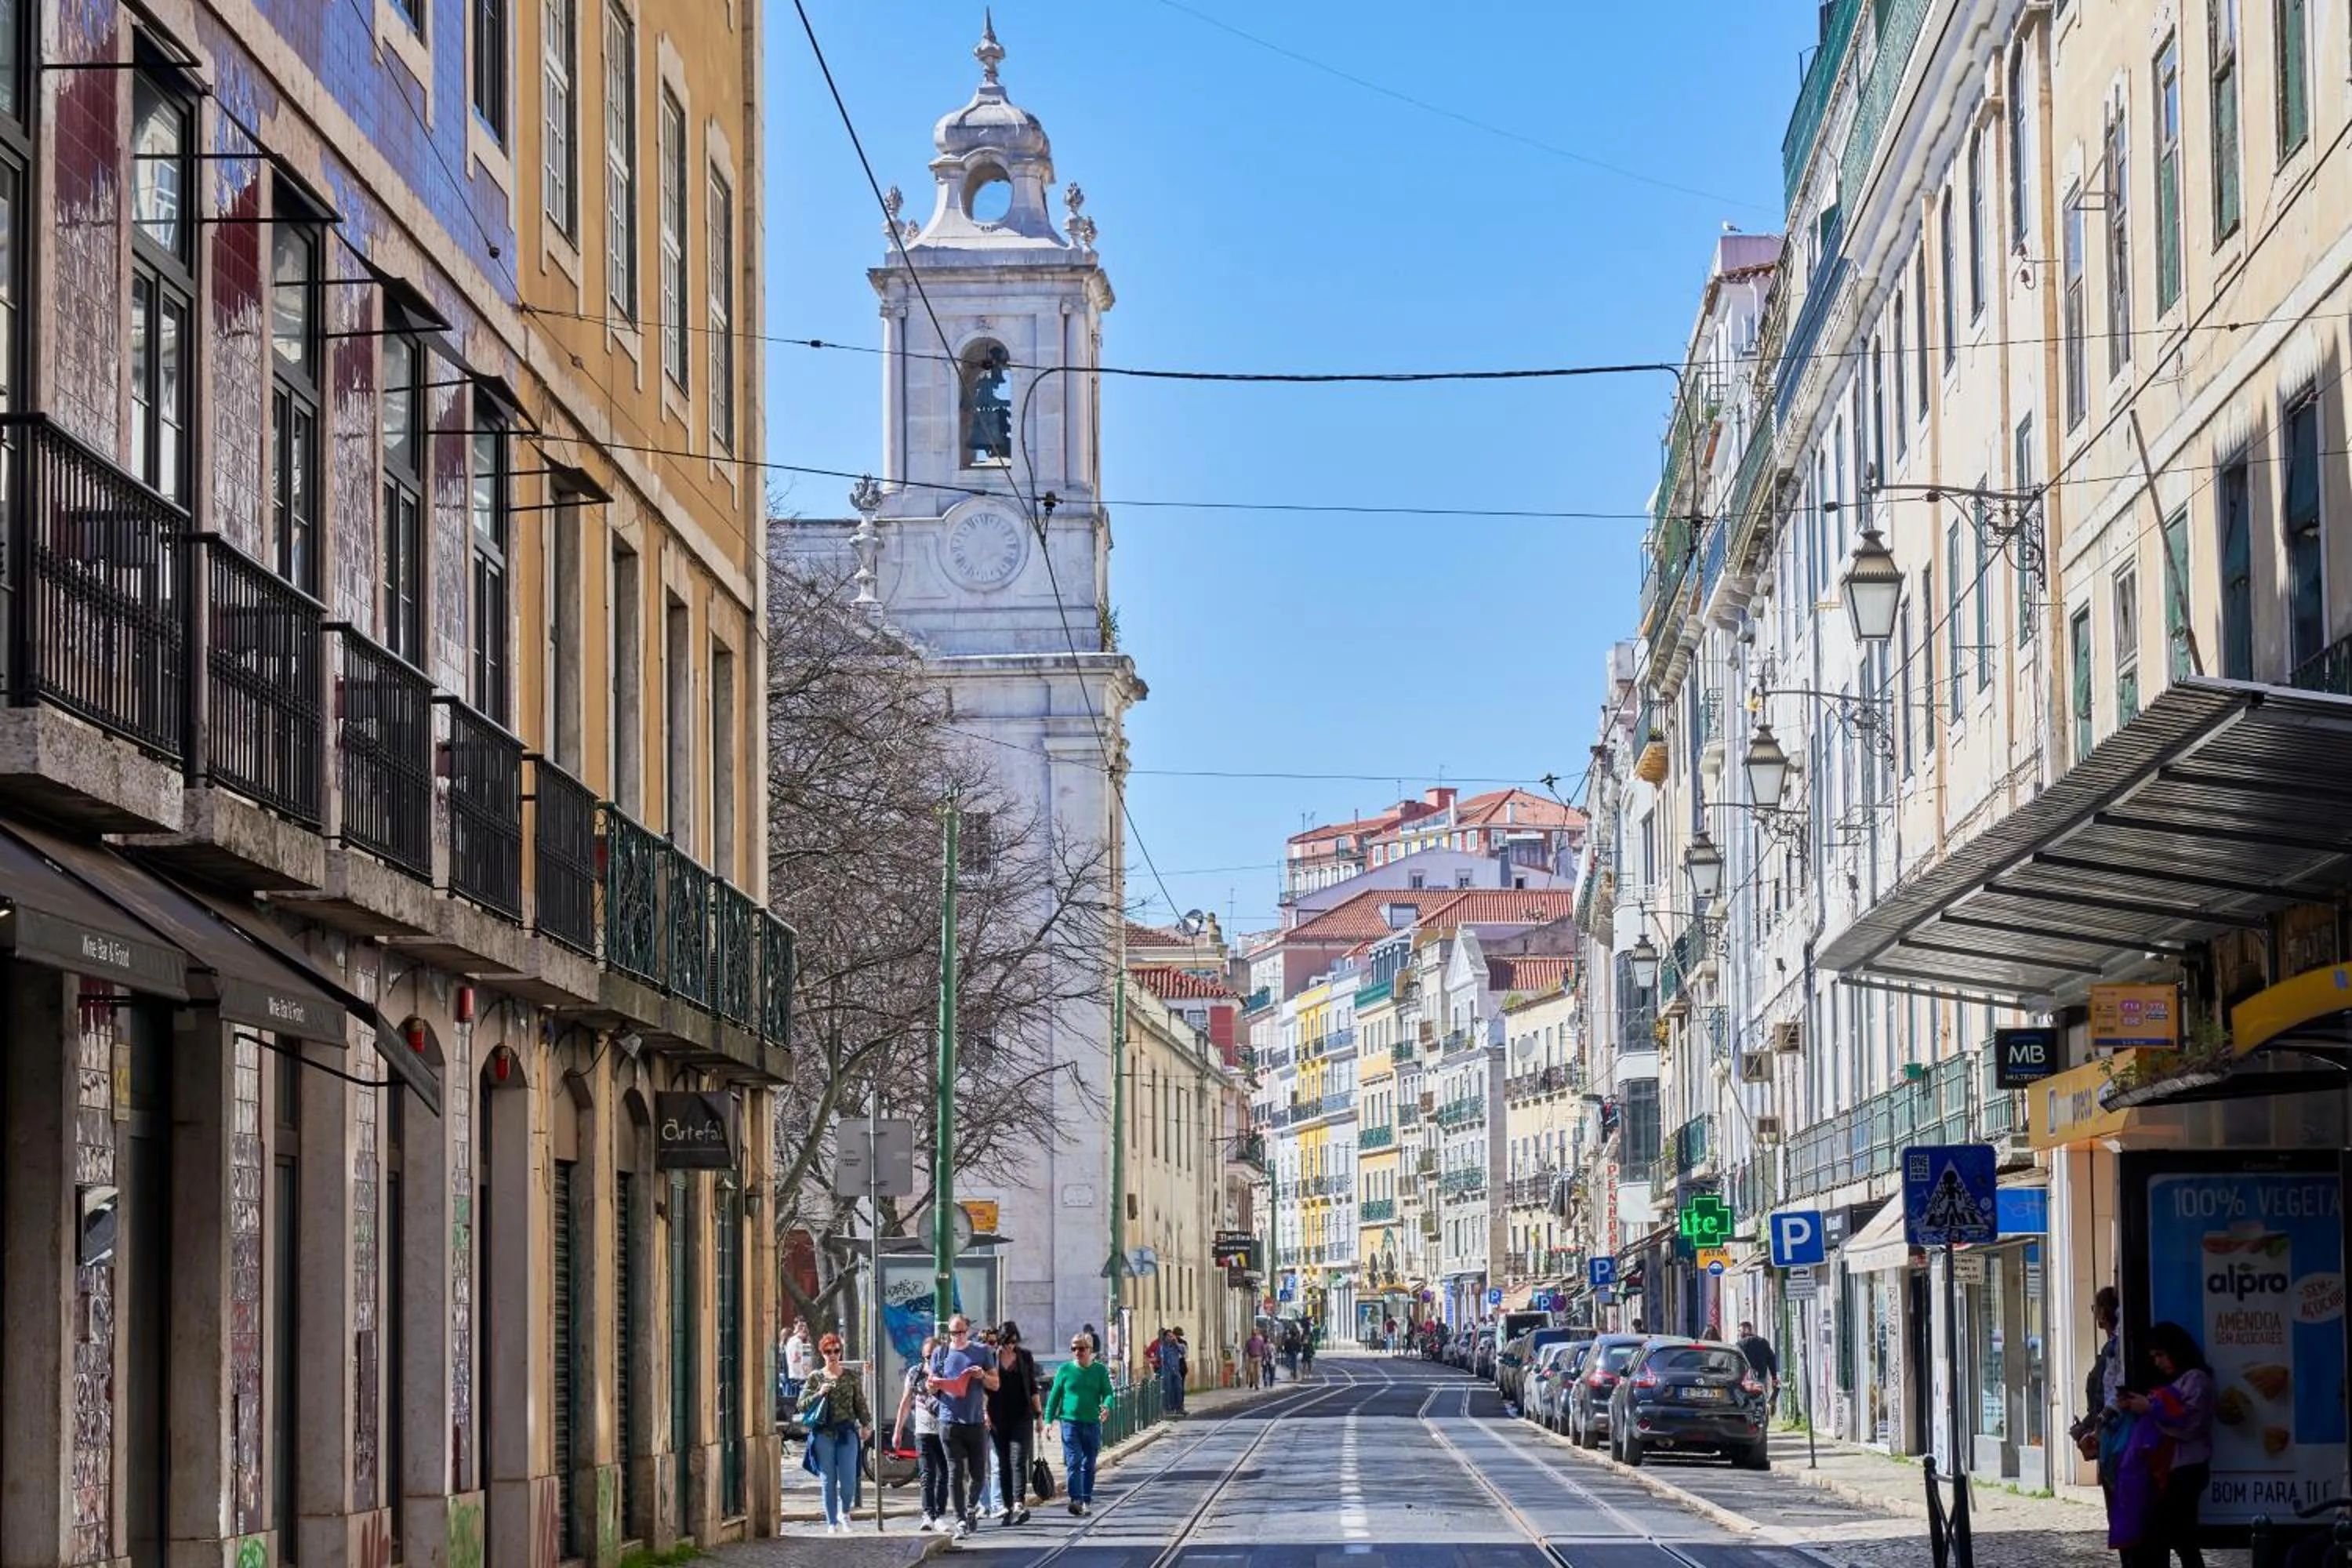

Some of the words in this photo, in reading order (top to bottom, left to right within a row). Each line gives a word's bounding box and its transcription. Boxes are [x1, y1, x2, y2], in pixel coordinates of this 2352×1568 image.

[2009, 1045, 2045, 1064] MB
[2173, 1185, 2247, 1218] 100%
[1781, 1218, 1811, 1260] P
[1594, 1260, 1610, 1282] P
[2207, 1264, 2288, 1302] alpro
[1541, 1298, 1550, 1311] P
[2212, 1481, 2246, 1503] BOM
[2254, 1481, 2297, 1504] PARA
